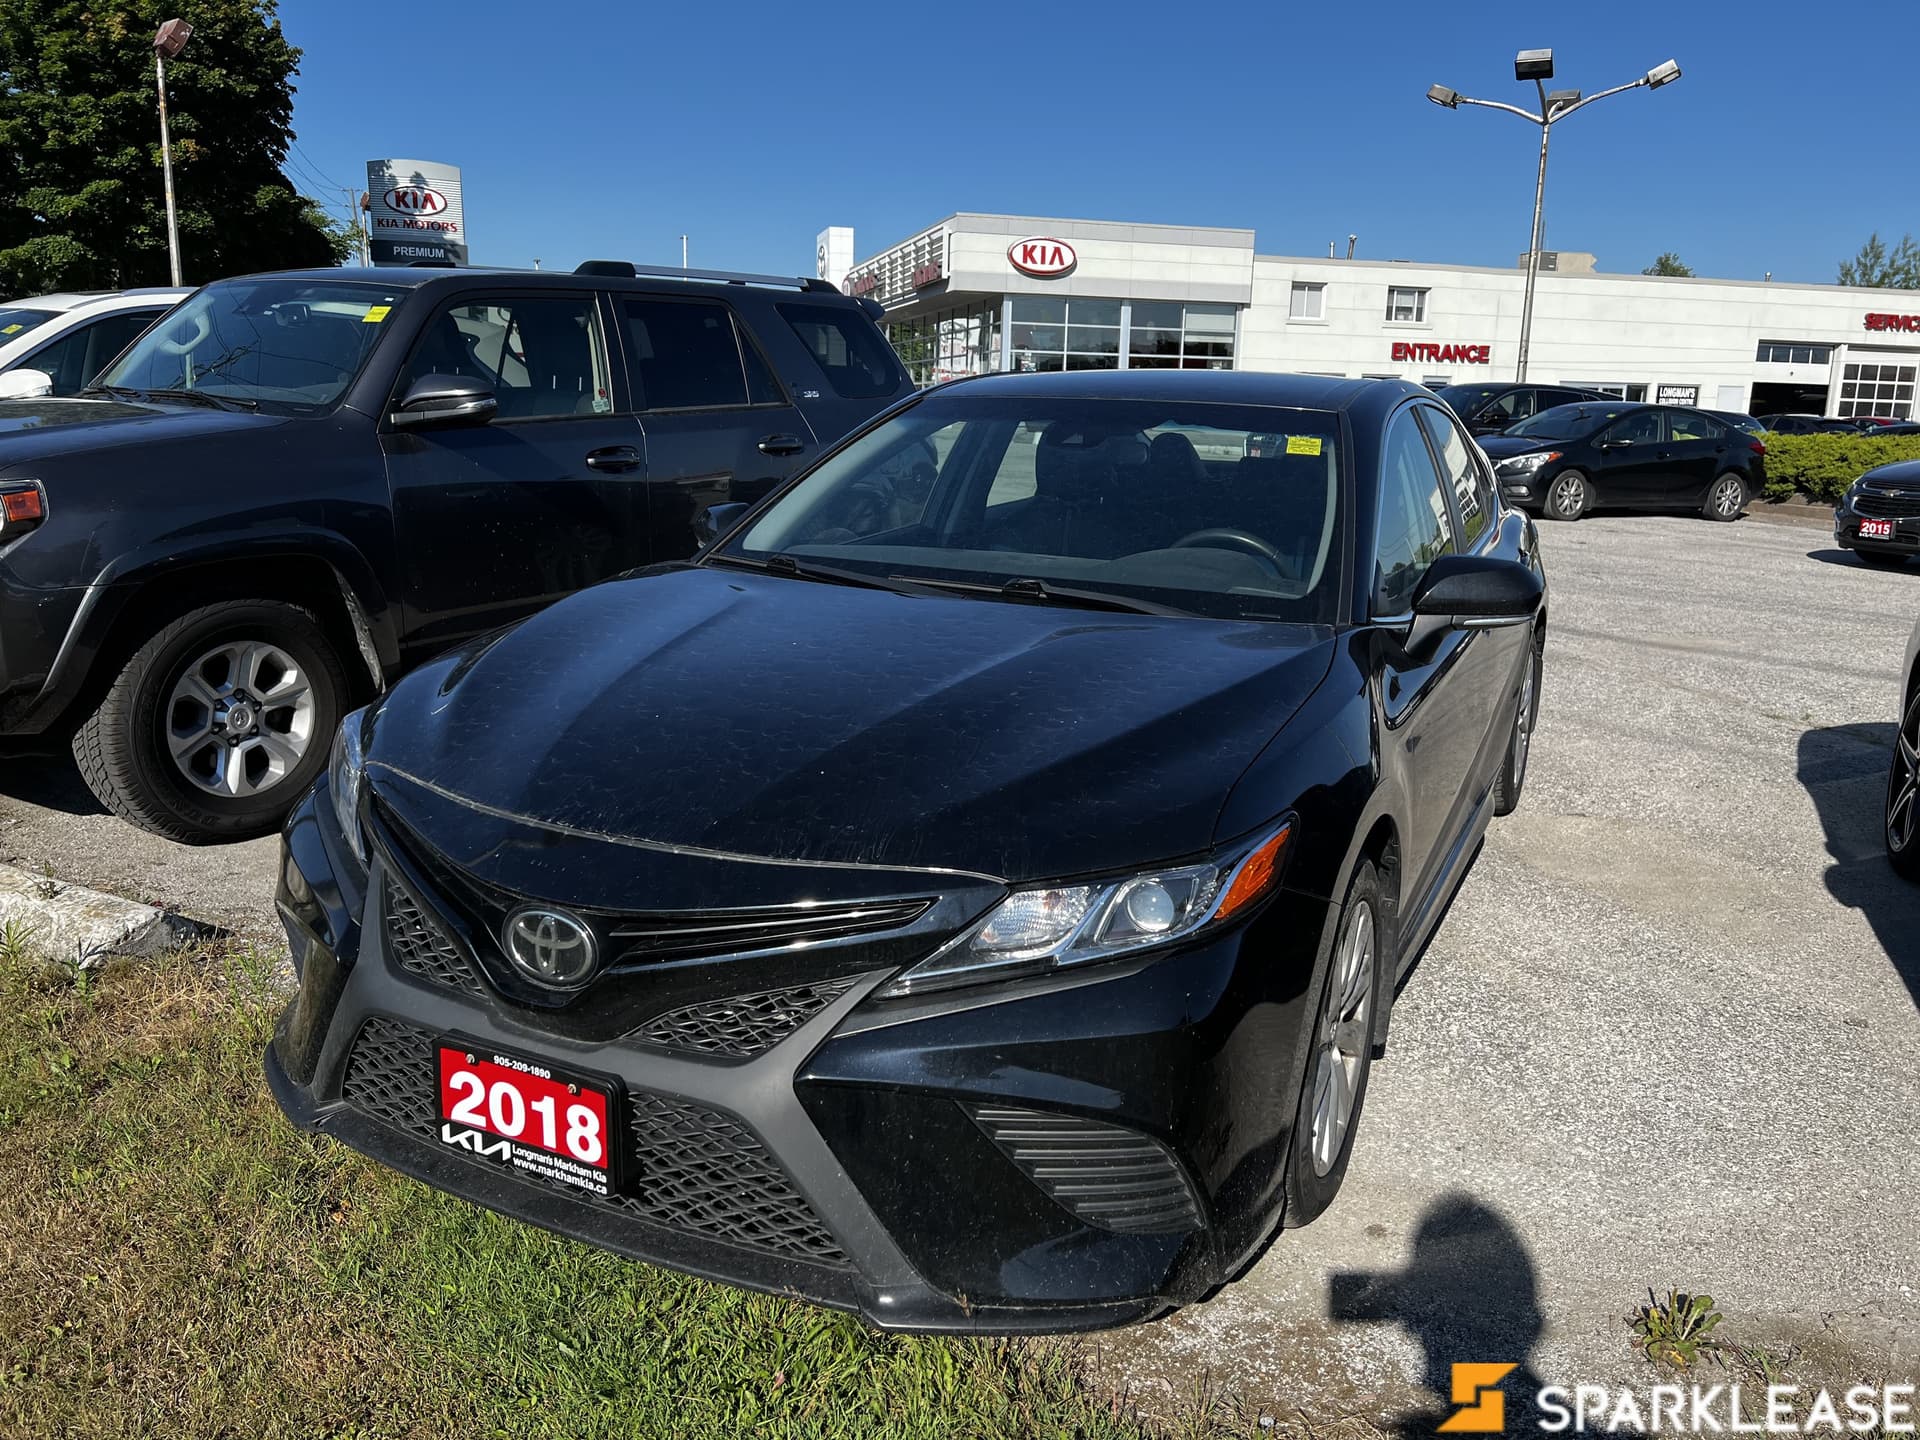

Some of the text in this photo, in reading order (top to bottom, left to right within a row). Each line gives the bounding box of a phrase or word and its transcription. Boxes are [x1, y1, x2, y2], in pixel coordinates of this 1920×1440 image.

[394, 190, 437, 210] KIA
[377, 218, 457, 232] KIA MOTORS
[393, 246, 445, 258] PREMIUM
[1022, 244, 1065, 266] KIA
[1391, 342, 1490, 364] ENTRANCE
[1861, 522, 1890, 535] 2015
[493, 1055, 551, 1079] 905-209-1890
[449, 1071, 602, 1163] 2018
[512, 1144, 608, 1183] Longman's Markham Kia
[512, 1157, 608, 1195] www.markhamkia.ca
